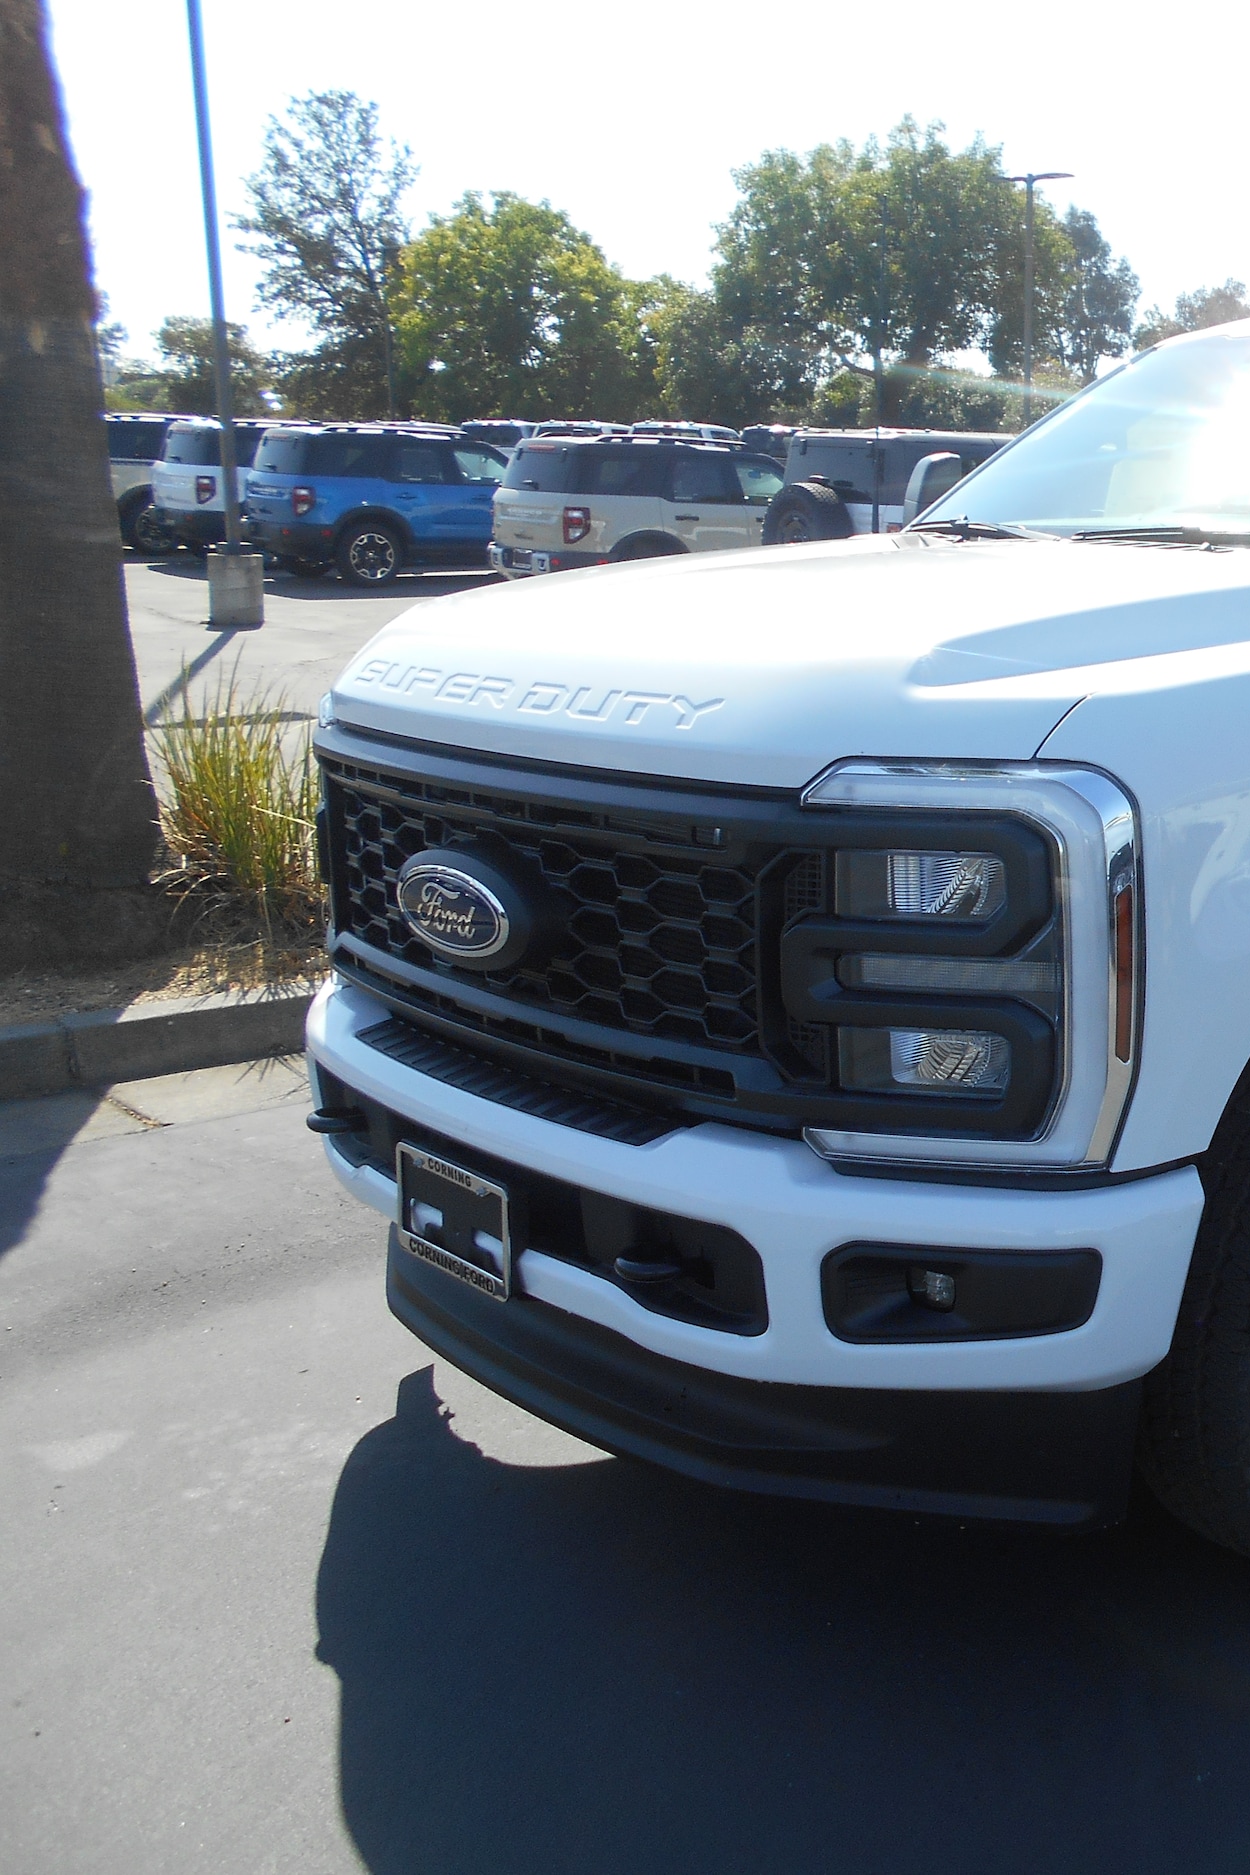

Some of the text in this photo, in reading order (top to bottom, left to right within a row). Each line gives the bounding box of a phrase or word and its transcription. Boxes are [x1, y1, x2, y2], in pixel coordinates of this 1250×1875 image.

[355, 658, 727, 730] SUPER DUTY
[417, 881, 476, 939] Ford
[427, 1158, 472, 1187] CORNING
